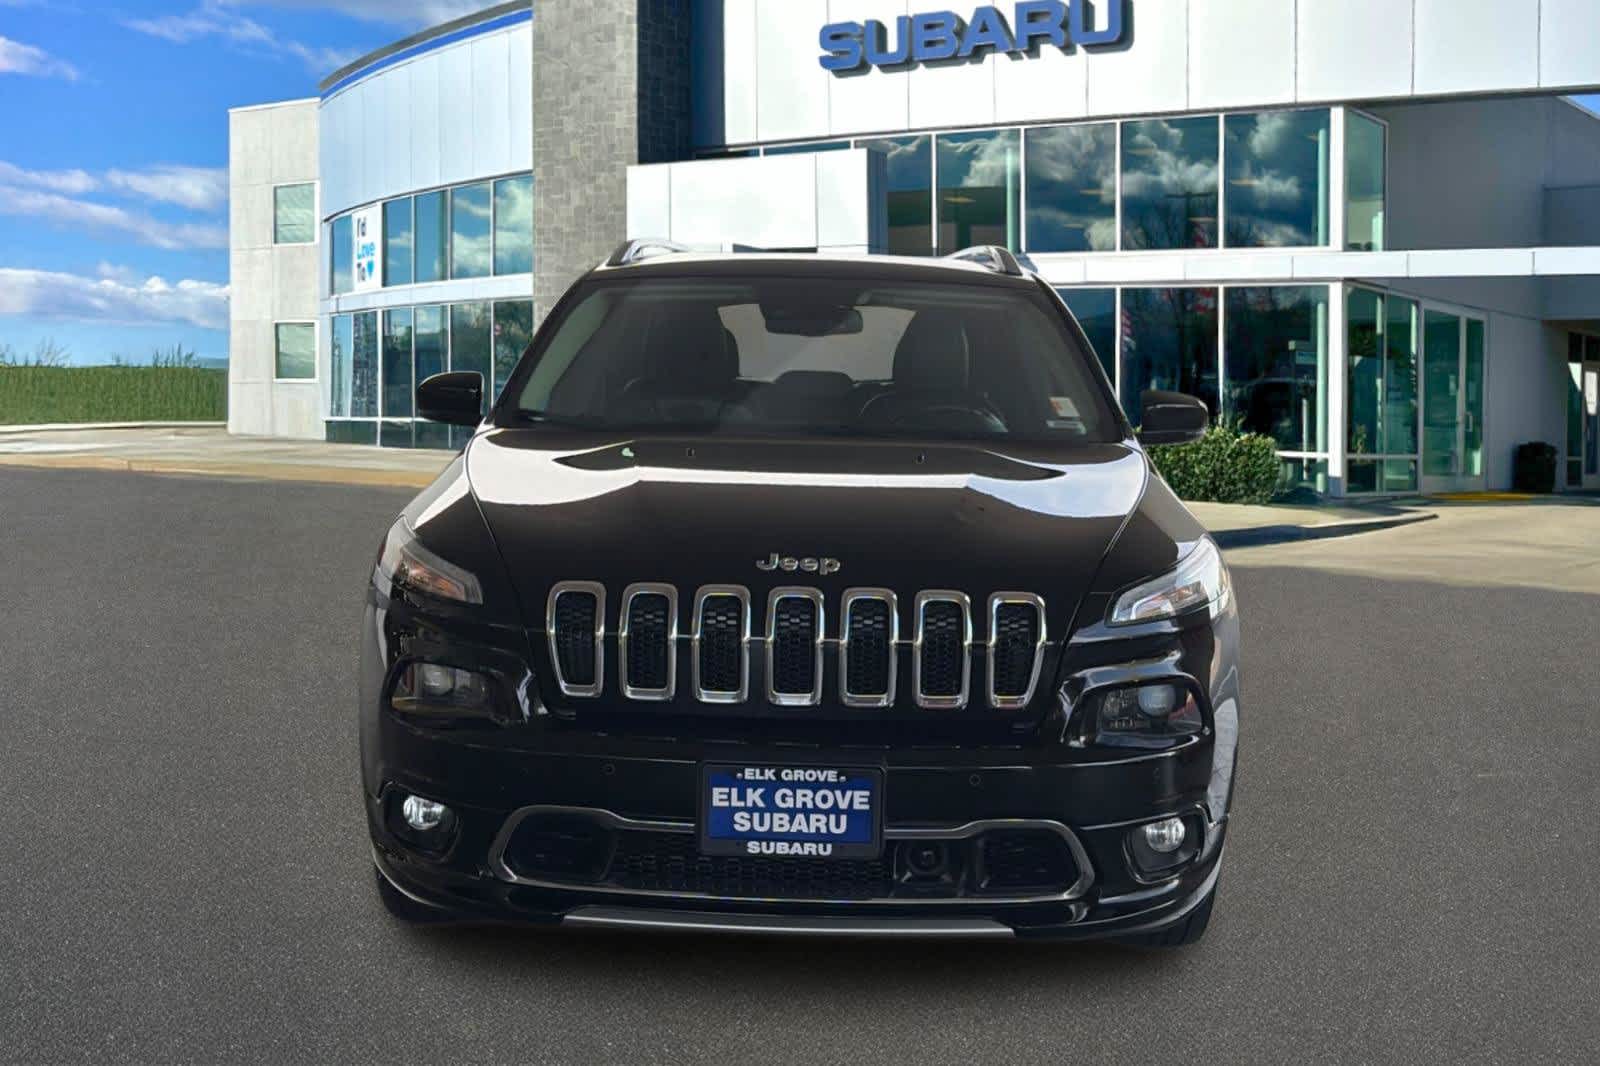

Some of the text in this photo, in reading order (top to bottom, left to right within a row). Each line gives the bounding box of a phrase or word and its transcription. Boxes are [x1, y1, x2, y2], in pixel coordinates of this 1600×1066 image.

[818, 0, 1131, 77] SUBARU
[756, 552, 840, 575] Jeep
[744, 768, 838, 782] ELK GROVE
[712, 787, 870, 810] ELK GROVE
[733, 812, 848, 834] SUBARU
[747, 840, 833, 856] SUBARU
